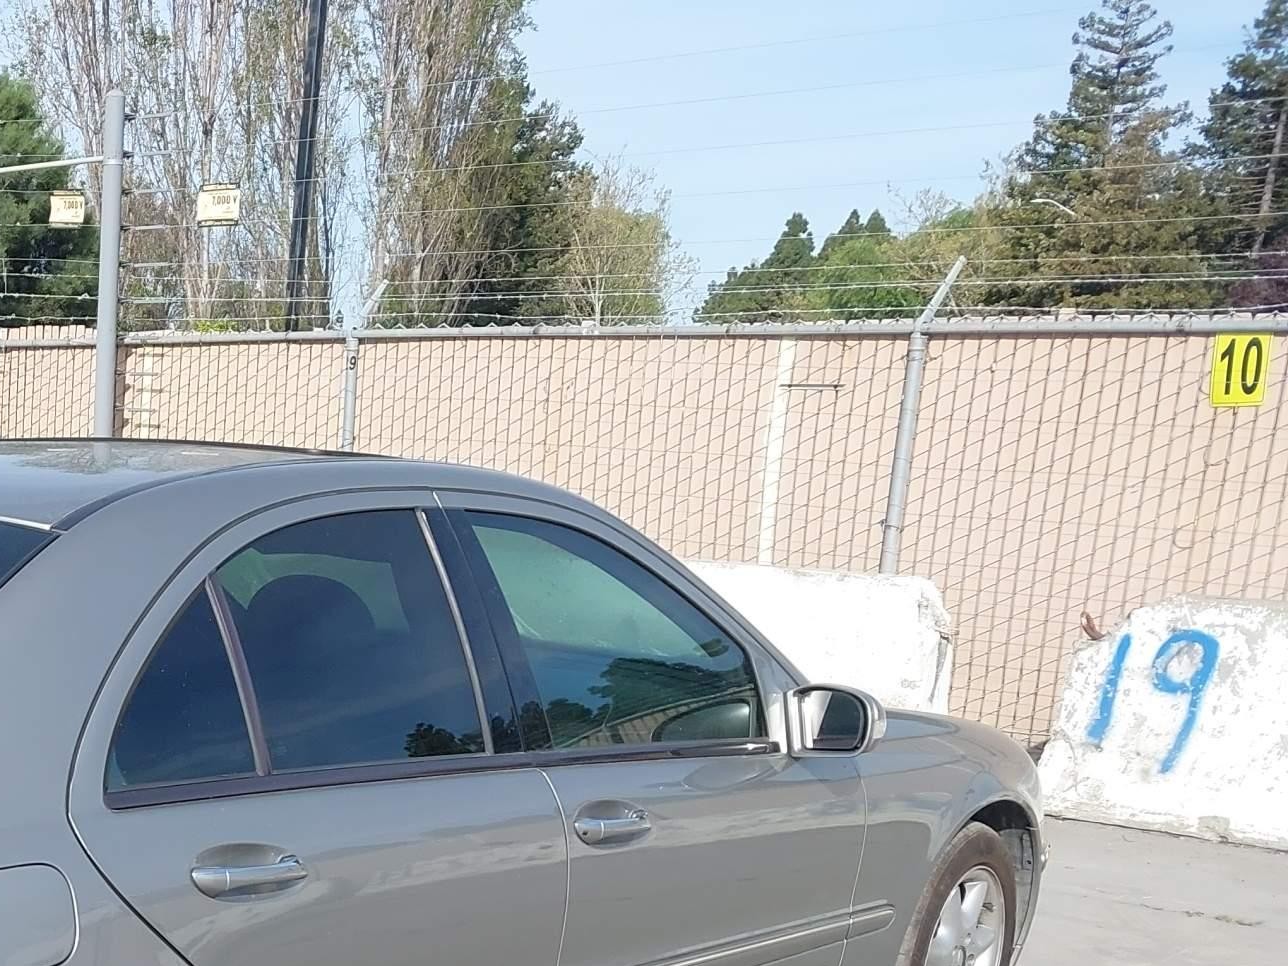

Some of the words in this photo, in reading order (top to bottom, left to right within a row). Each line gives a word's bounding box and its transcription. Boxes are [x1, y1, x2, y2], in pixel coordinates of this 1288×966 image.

[212, 195, 231, 206] 7,000
[349, 355, 357, 371] 9
[1220, 336, 1263, 395] 10
[1085, 629, 1221, 775] 19
